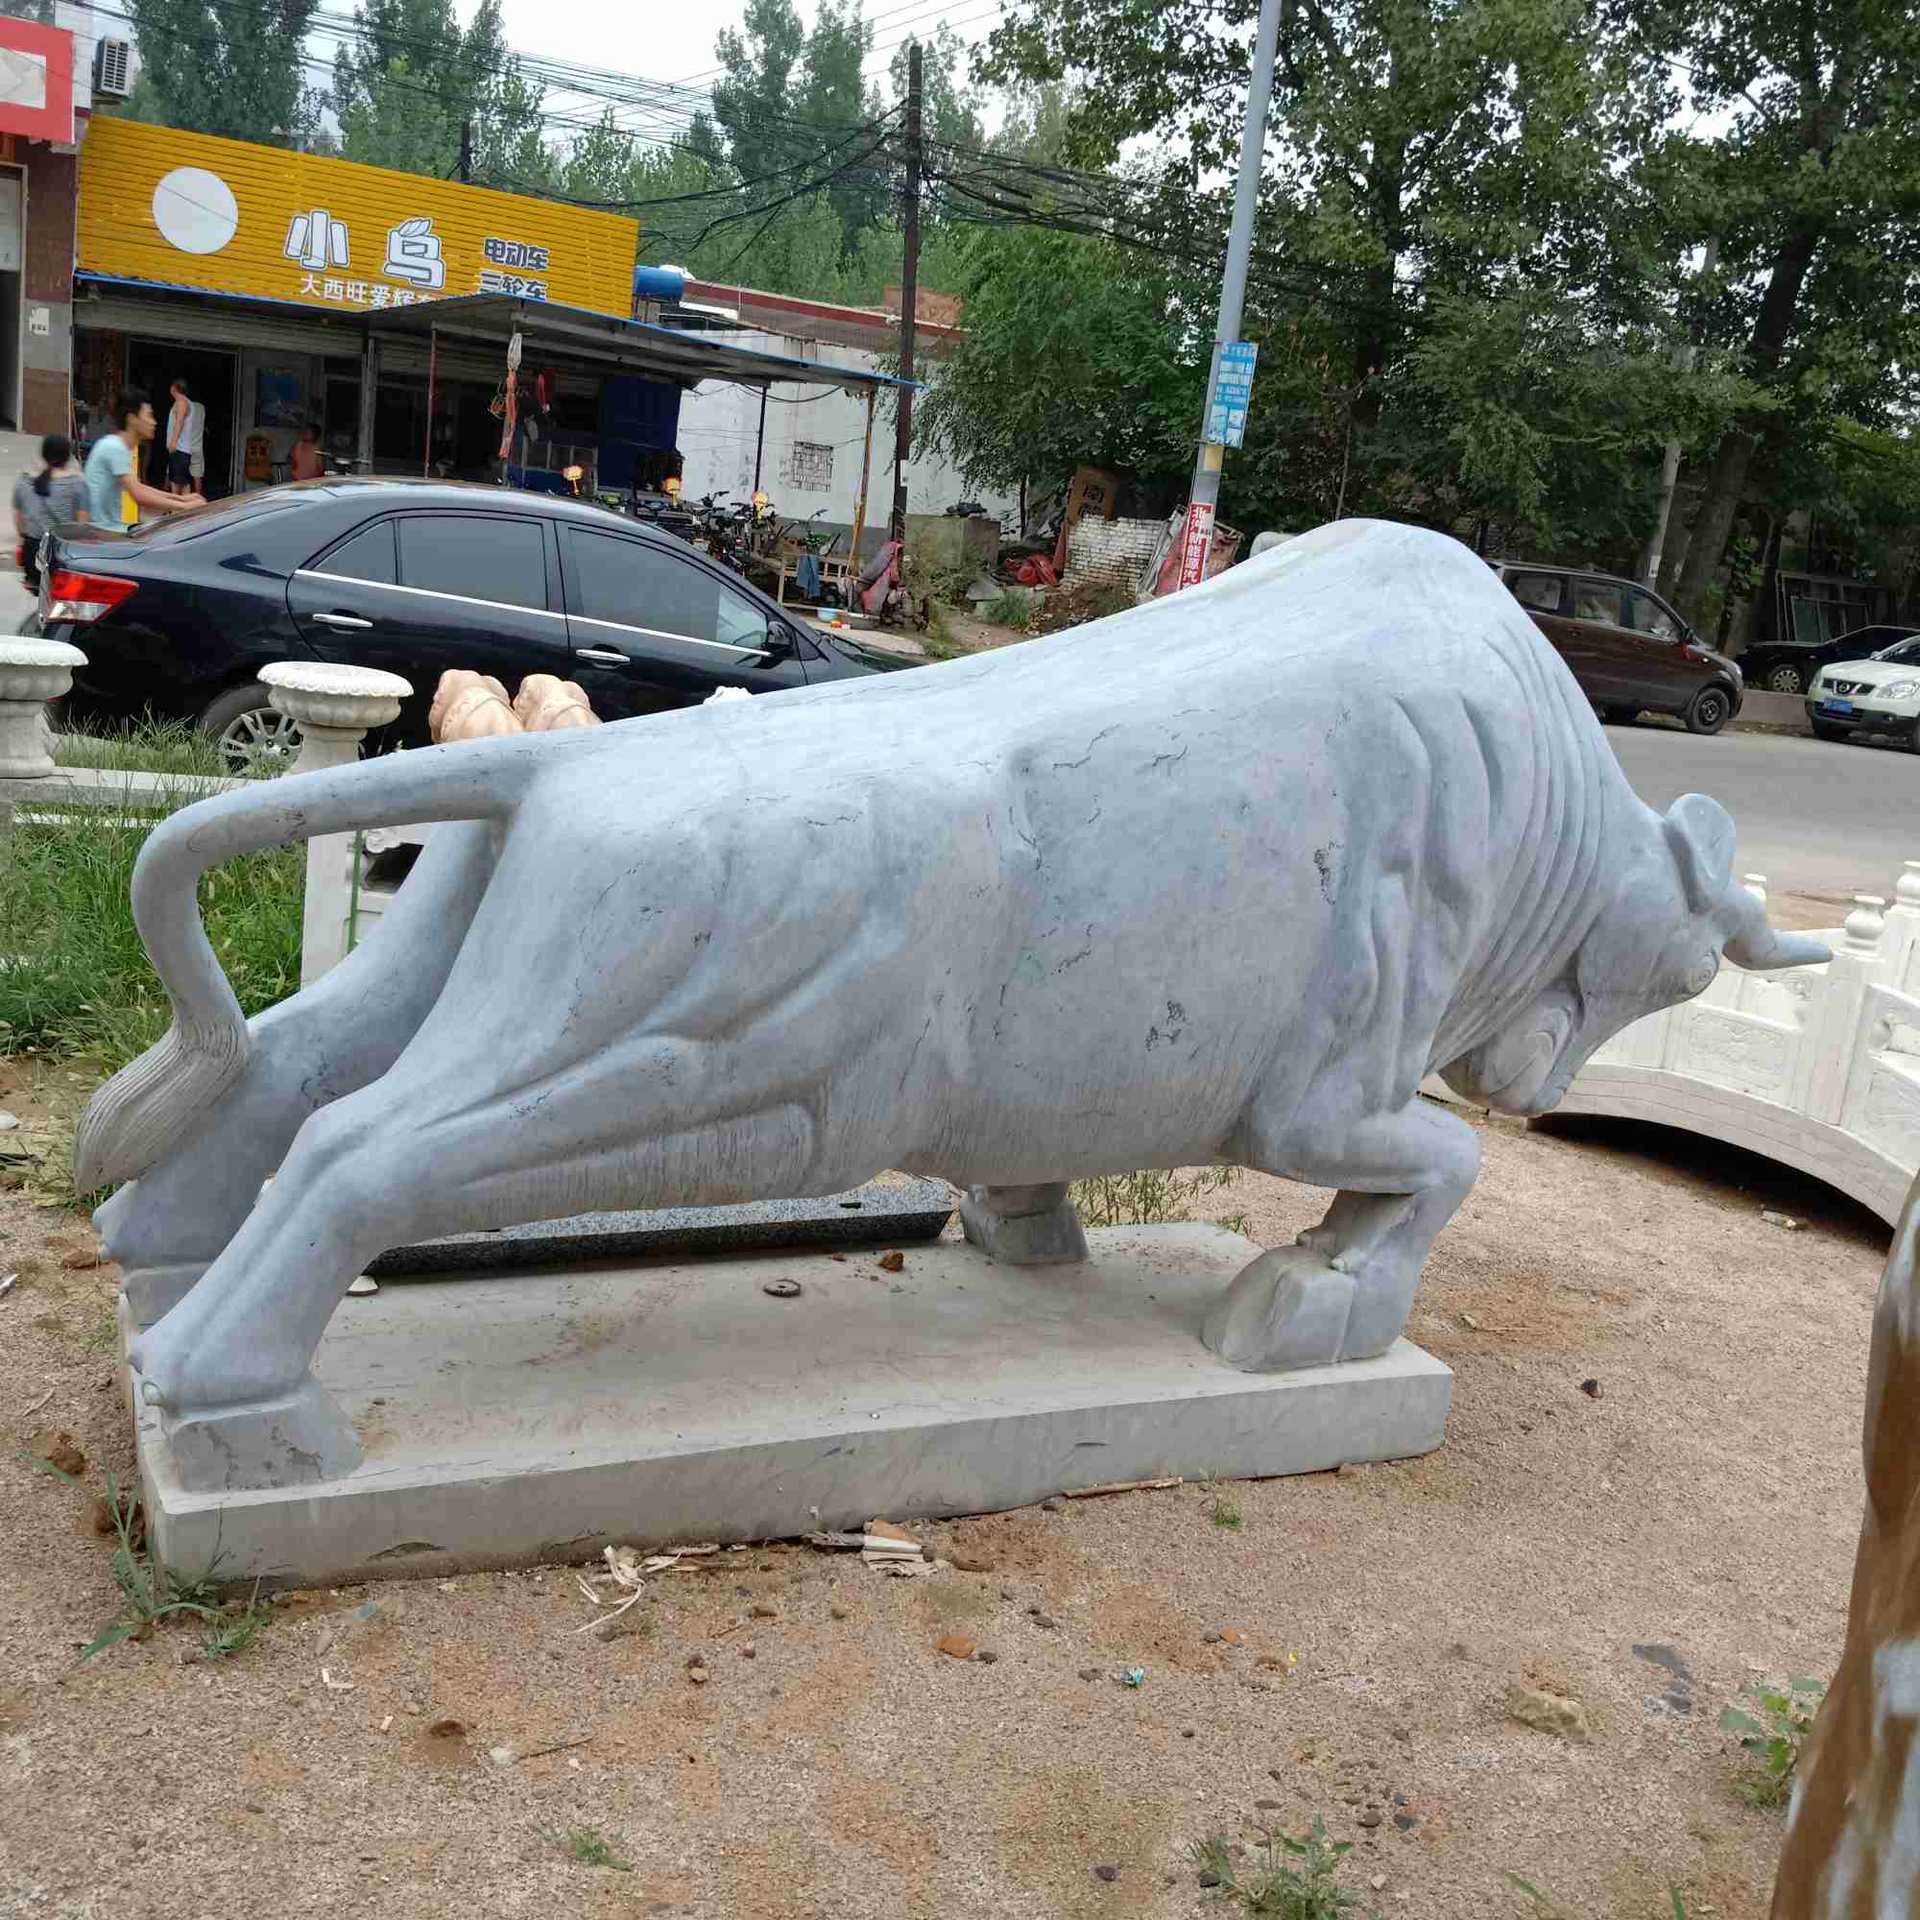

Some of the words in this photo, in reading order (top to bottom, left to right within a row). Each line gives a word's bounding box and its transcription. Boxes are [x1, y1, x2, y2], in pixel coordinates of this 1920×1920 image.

[483, 237, 551, 272] 电动车
[479, 268, 547, 302] 三轮车
